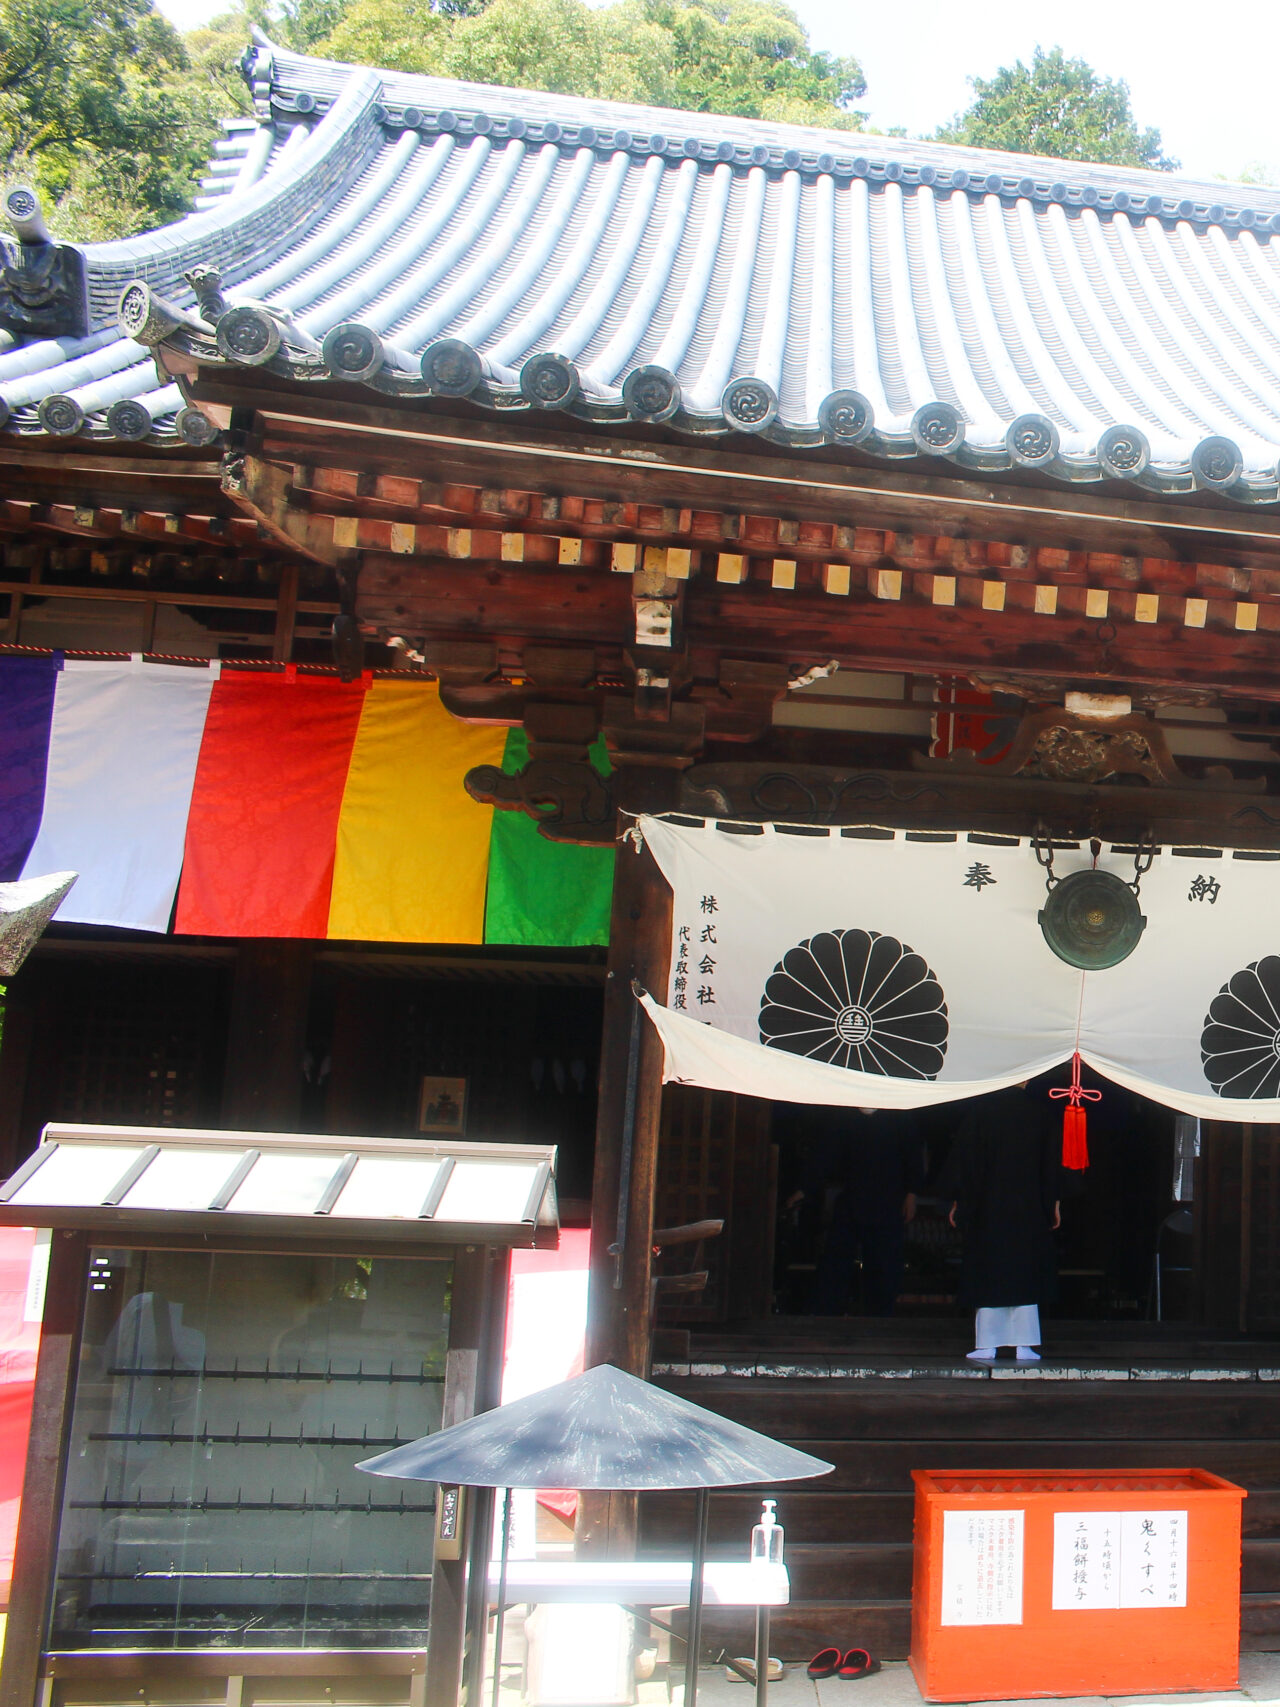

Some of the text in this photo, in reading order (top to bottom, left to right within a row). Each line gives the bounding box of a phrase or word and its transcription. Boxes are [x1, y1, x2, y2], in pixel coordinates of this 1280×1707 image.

[962, 861, 1222, 905] 奉 納
[672, 925, 691, 1011] 代表取締役
[695, 894, 719, 1026] 株式会社
[442, 1493, 456, 1536] おさいせん
[1102, 1527, 1112, 1591] 十五時頃から
[1140, 1518, 1158, 1595] 鬼くすべ
[1168, 1519, 1179, 1602] 四月十六日十四時
